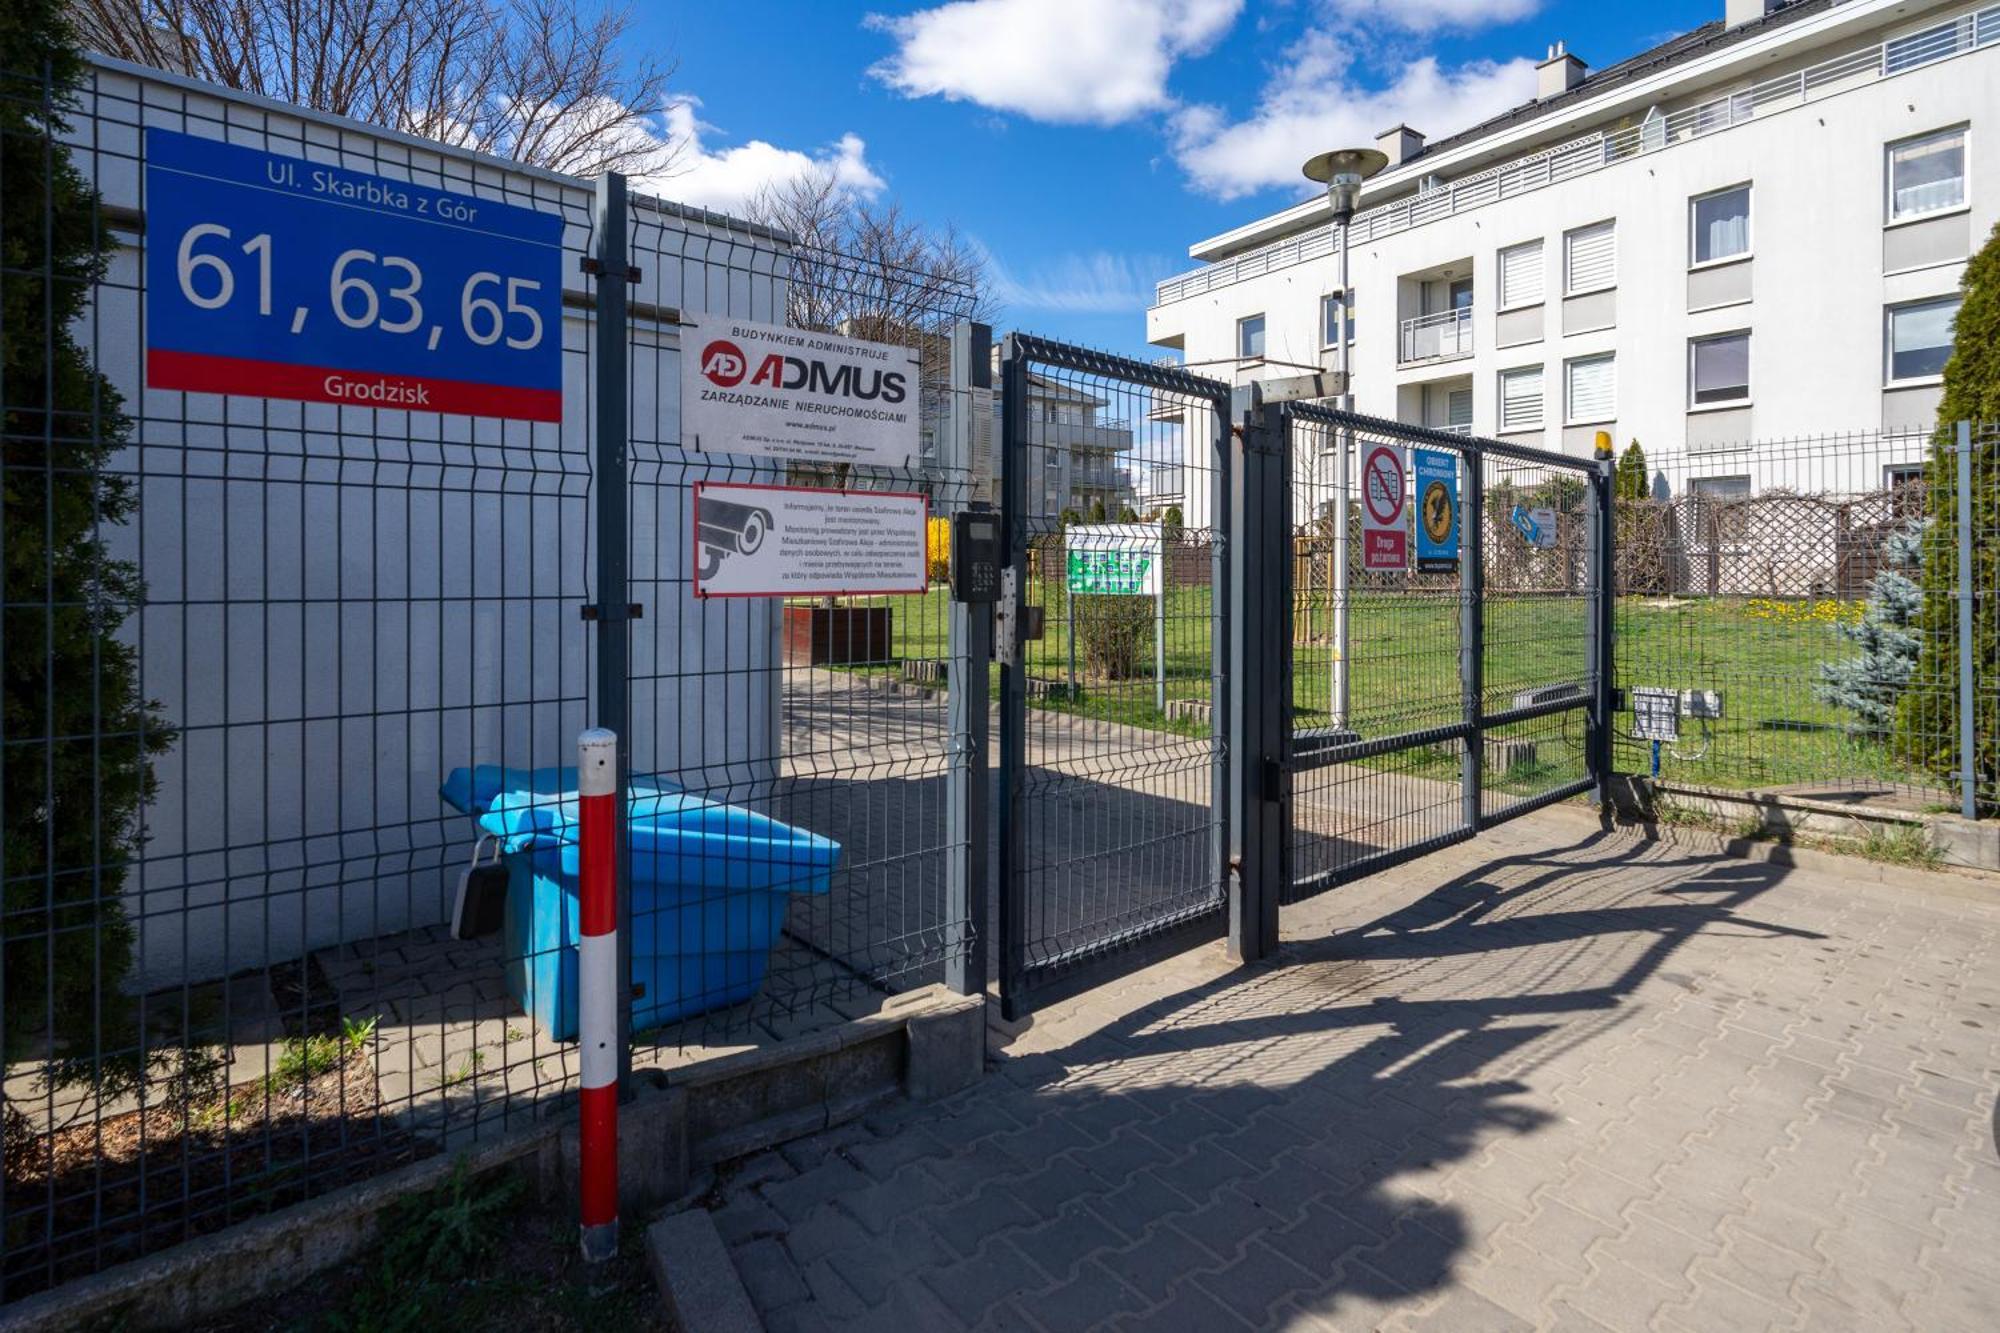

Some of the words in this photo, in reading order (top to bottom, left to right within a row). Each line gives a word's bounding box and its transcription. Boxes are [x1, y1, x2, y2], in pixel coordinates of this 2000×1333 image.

[267, 160, 301, 189] Ul.
[312, 171, 409, 210] Skarbka
[418, 196, 429, 214] z
[437, 198, 478, 224] Gór
[177, 224, 308, 334] 61,
[330, 249, 443, 350] 63,
[461, 272, 544, 350] 65
[732, 326, 805, 348] BUDYNKIEM
[808, 340, 889, 361] ADMINISTRUJE
[324, 376, 430, 405] Grodzisk
[750, 354, 906, 404] ADMUS
[701, 390, 789, 410] ZARZĄDZANIE
[795, 402, 907, 423] NIERUCHOMOŚCIAMI
